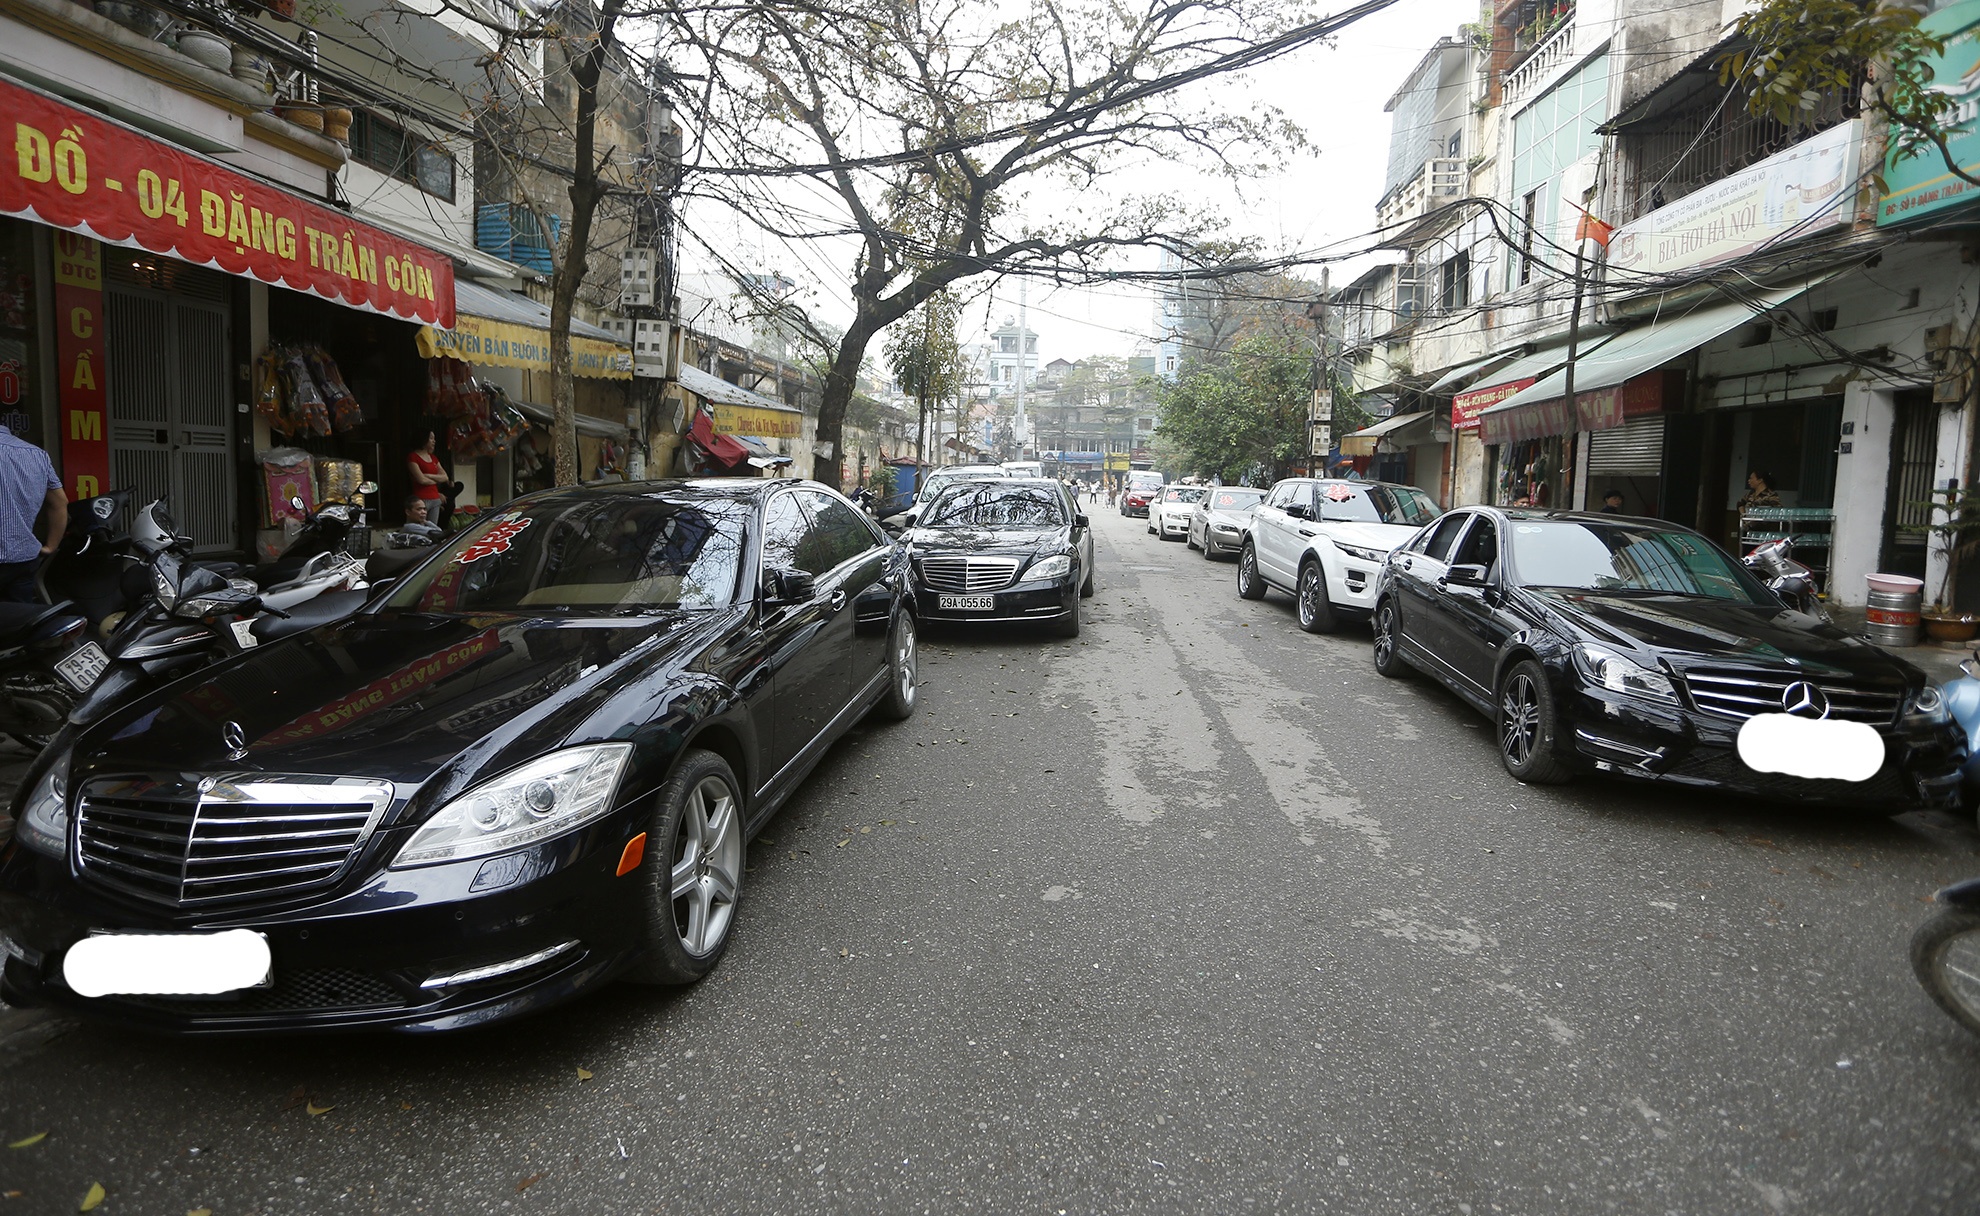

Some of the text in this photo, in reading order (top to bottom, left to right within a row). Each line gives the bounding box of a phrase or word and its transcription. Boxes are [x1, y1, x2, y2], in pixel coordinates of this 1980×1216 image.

[15, 122, 88, 195] ĐỒ
[137, 168, 188, 228] 04
[200, 189, 297, 262] ĐẶNG
[304, 228, 378, 286] TRẦN
[385, 252, 435, 303] CÔN
[1658, 238, 1677, 264] BIA
[1680, 226, 1707, 256] HƠI
[1707, 211, 1728, 246] HÀ
[1730, 201, 1757, 240] NỘI
[61, 261, 97, 281] ĐTC
[433, 329, 481, 354] CHUYÊN
[484, 335, 509, 357] BÁN
[511, 340, 540, 361] BUÔN
[941, 597, 992, 608] 29A-055.66
